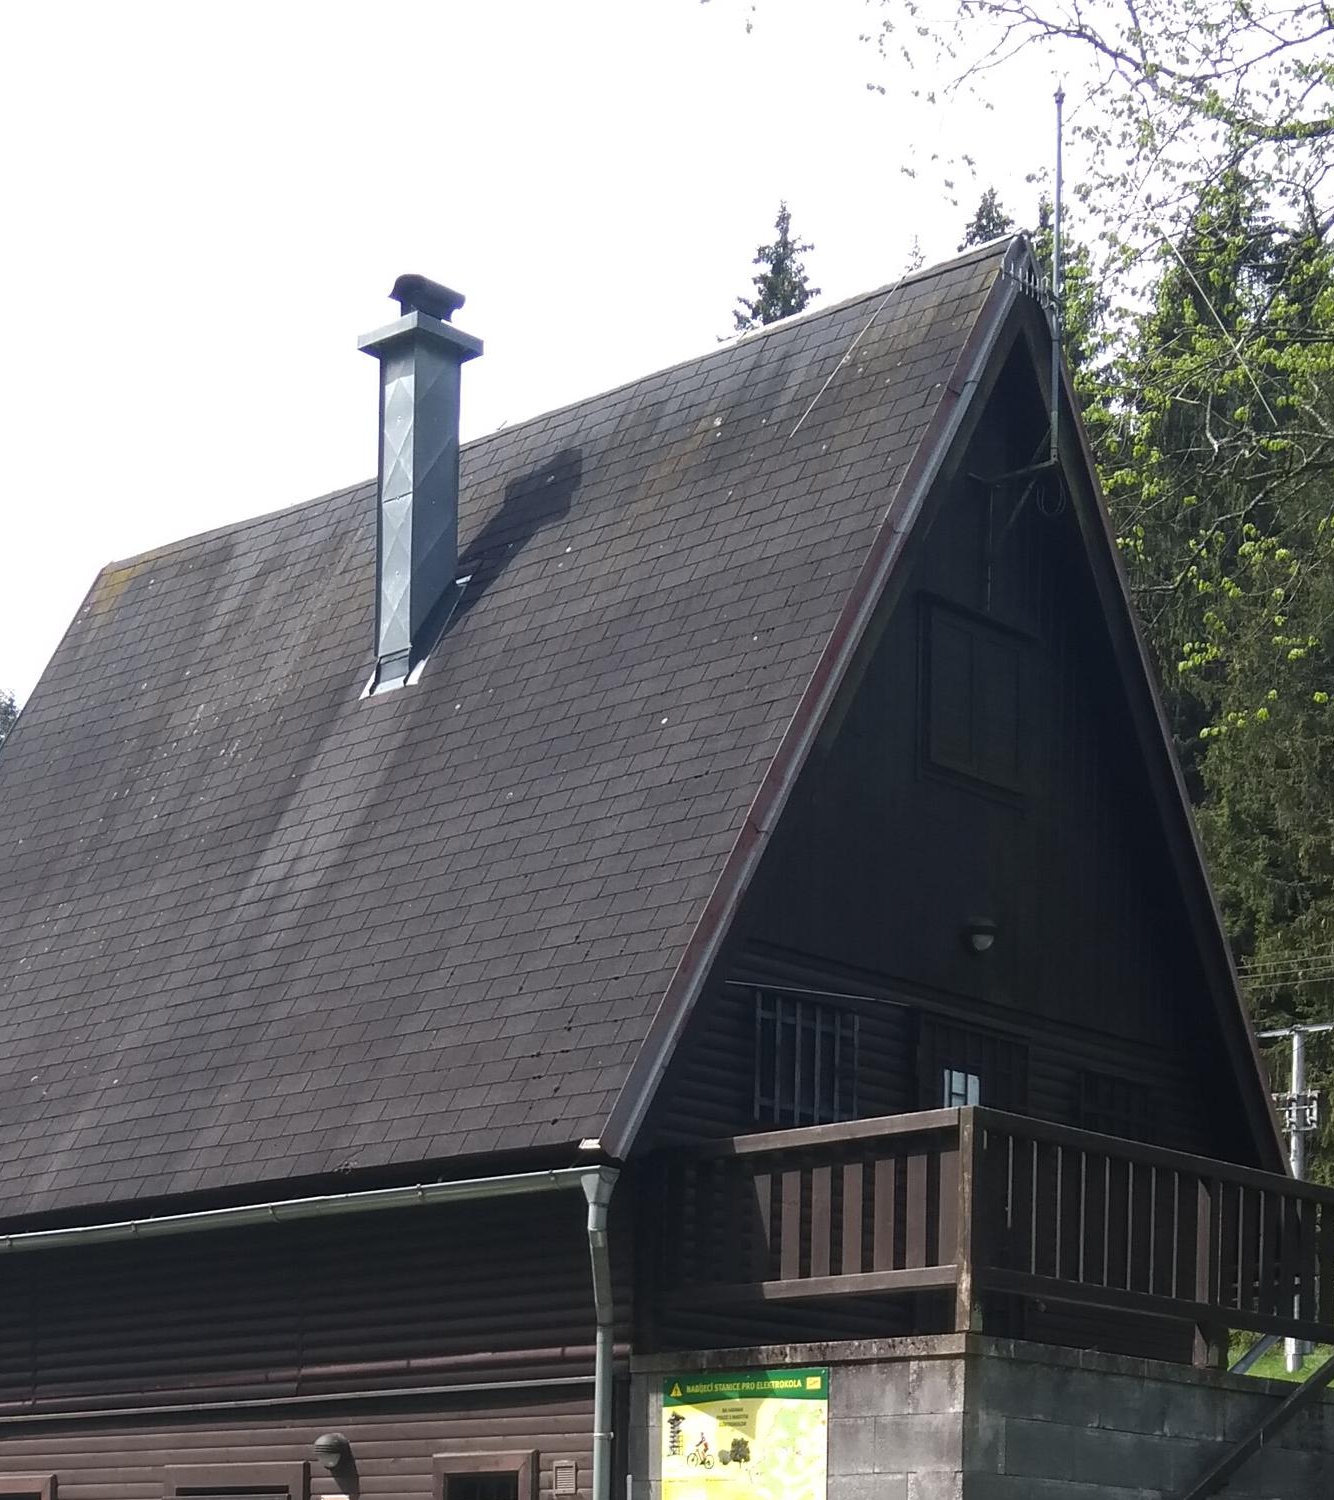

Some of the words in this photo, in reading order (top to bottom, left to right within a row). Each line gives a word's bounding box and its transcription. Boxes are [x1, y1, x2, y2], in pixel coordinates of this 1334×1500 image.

[714, 1382, 740, 1392] STANICE
[742, 1381, 755, 1391] PRO
[757, 1379, 802, 1390] ELEKTROKOLA
